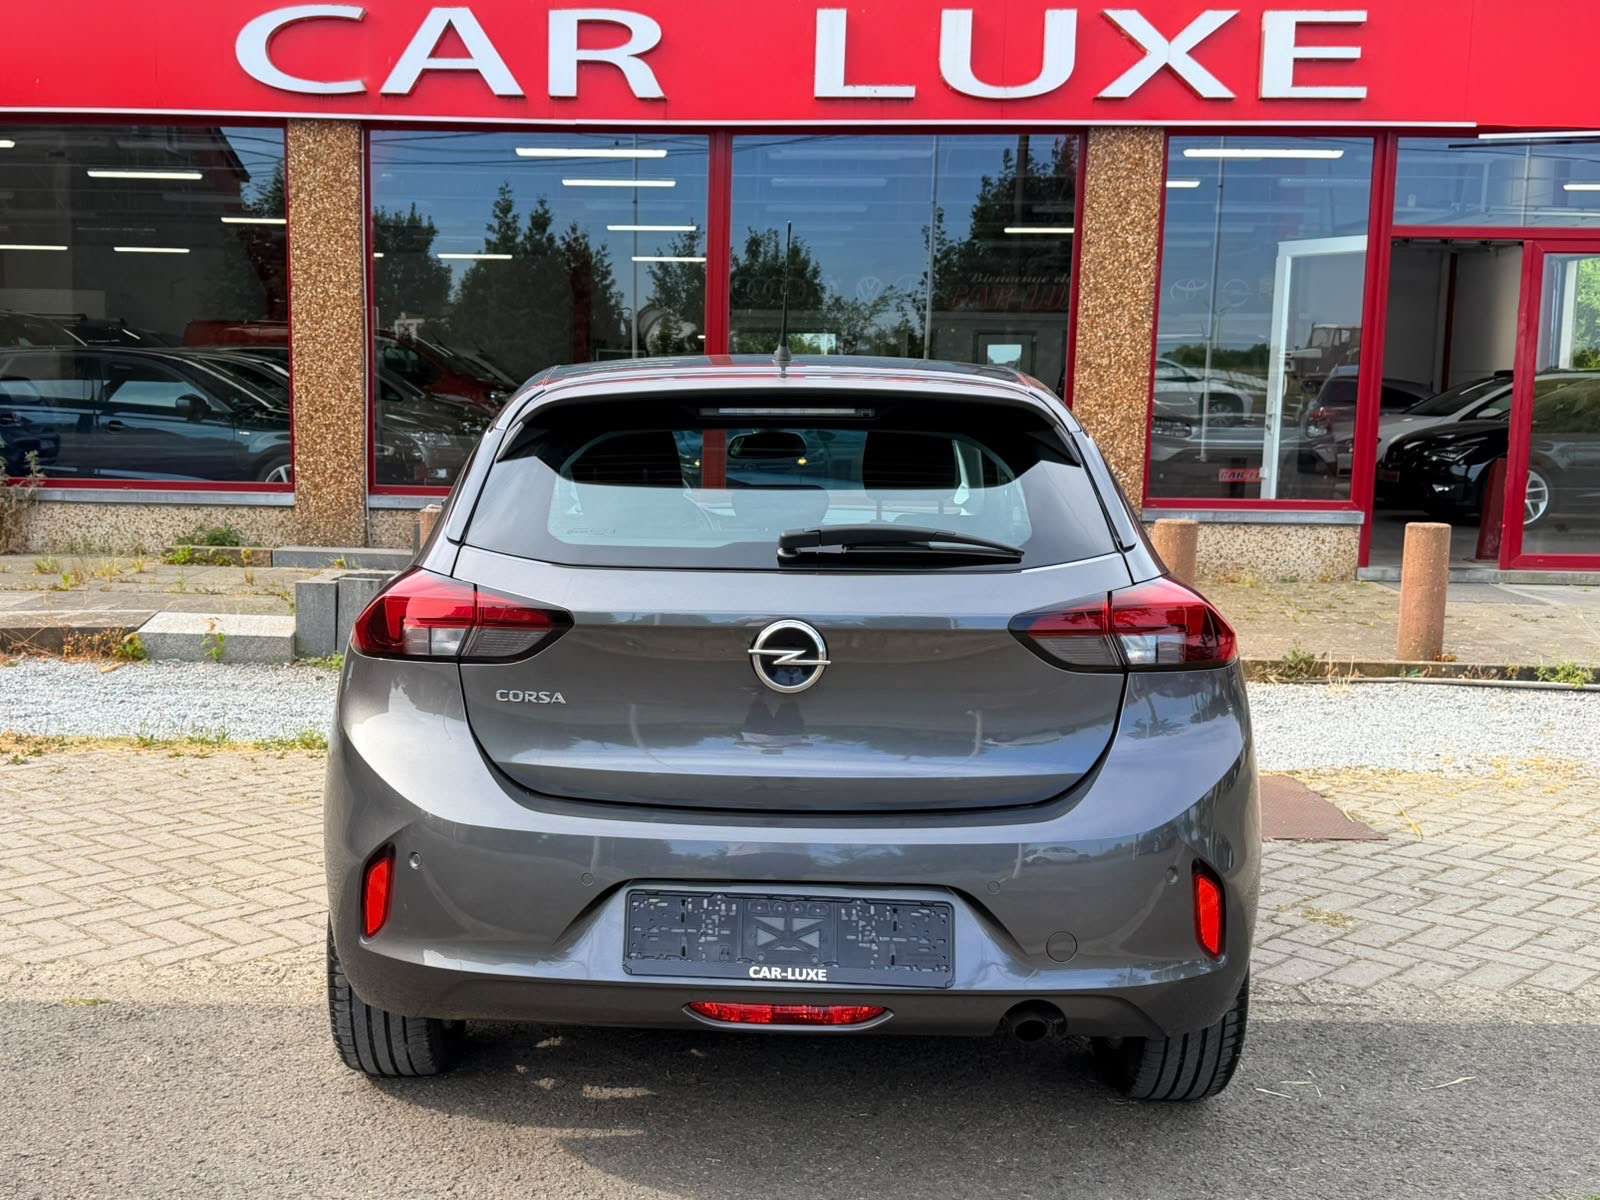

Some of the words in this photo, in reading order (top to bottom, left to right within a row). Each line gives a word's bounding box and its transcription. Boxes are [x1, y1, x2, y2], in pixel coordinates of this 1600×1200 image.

[235, 3, 666, 99] CAR
[813, 7, 1368, 101] LUXE
[495, 688, 567, 705] CORSA
[748, 965, 828, 982] CAR-LUXE
